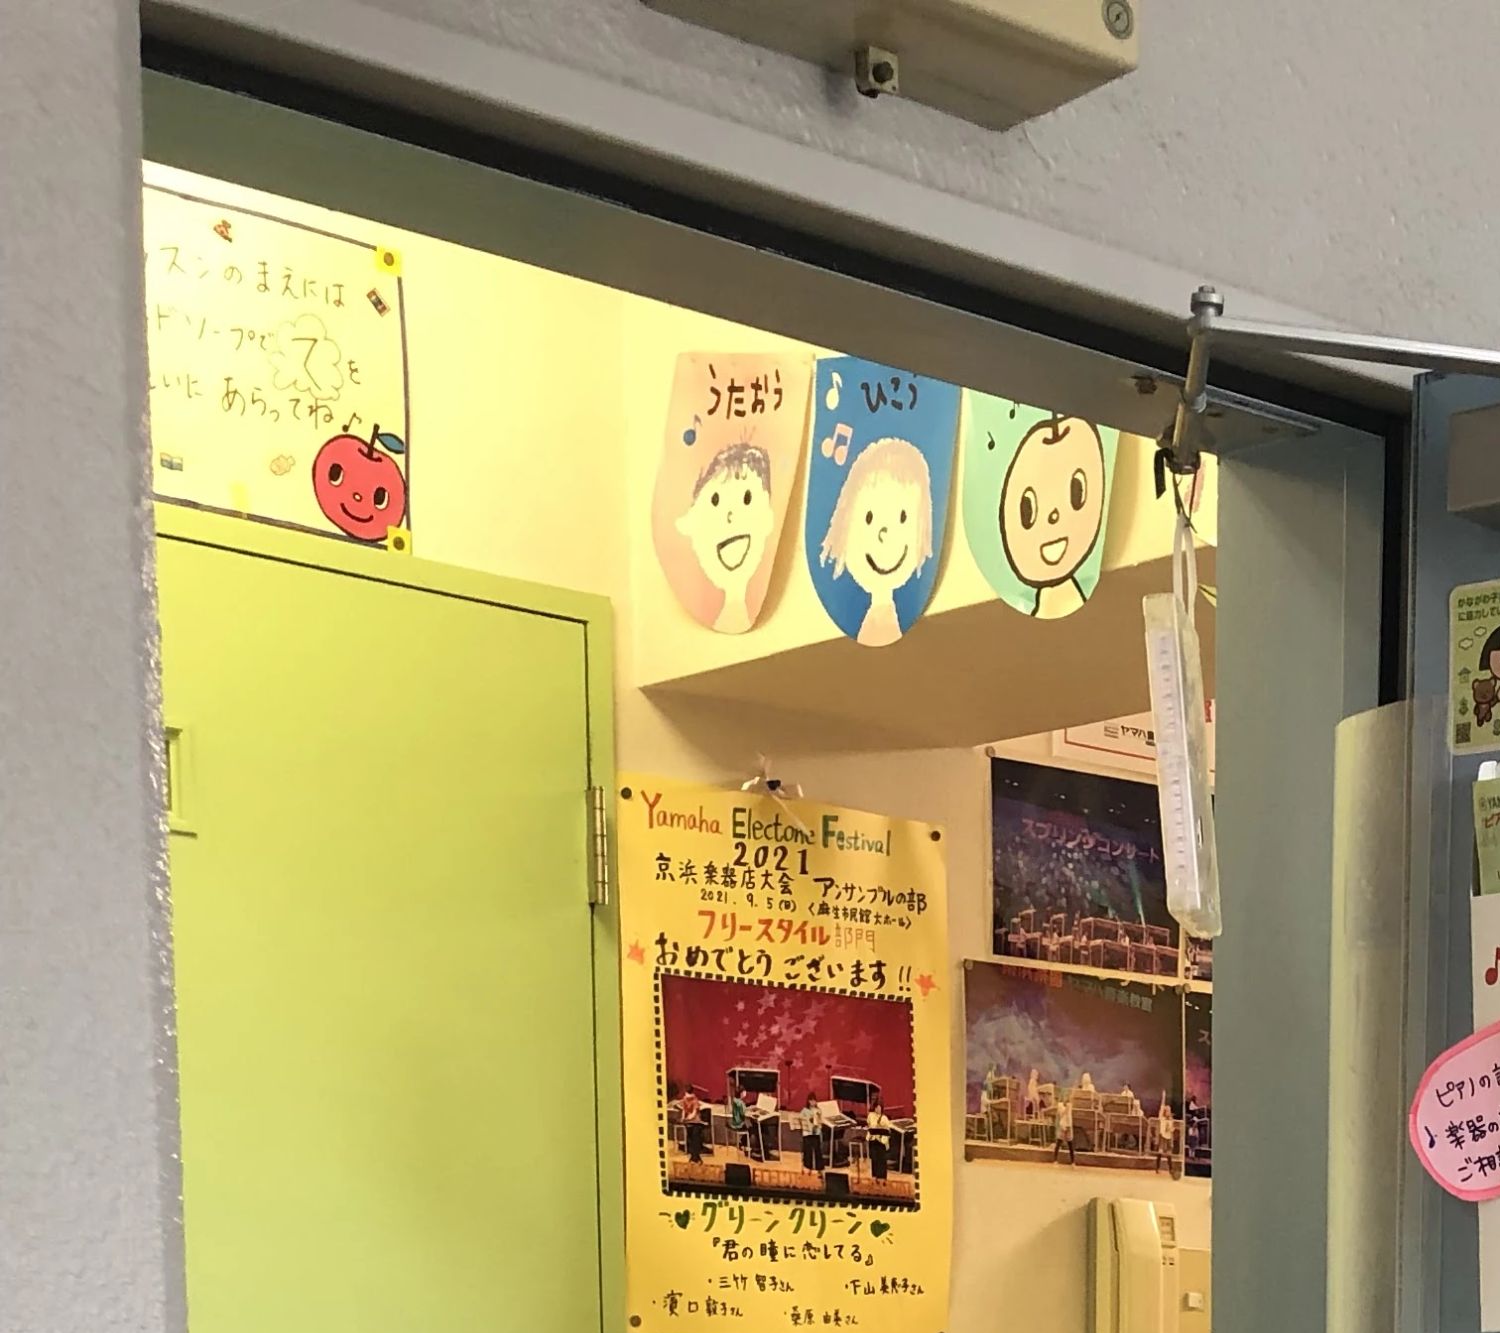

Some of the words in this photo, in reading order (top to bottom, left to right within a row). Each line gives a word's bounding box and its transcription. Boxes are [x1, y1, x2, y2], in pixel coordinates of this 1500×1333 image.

[146, 247, 344, 307] スンのまえには
[706, 363, 784, 416] うたおう
[861, 374, 919, 411] ひこう
[641, 790, 723, 835] Yamaha
[732, 807, 815, 844] Electone
[821, 815, 891, 856] Festival
[1021, 817, 1160, 863] スプリングコンサート
[655, 852, 795, 896] 京浜楽器店大会
[733, 842, 809, 875] 2021
